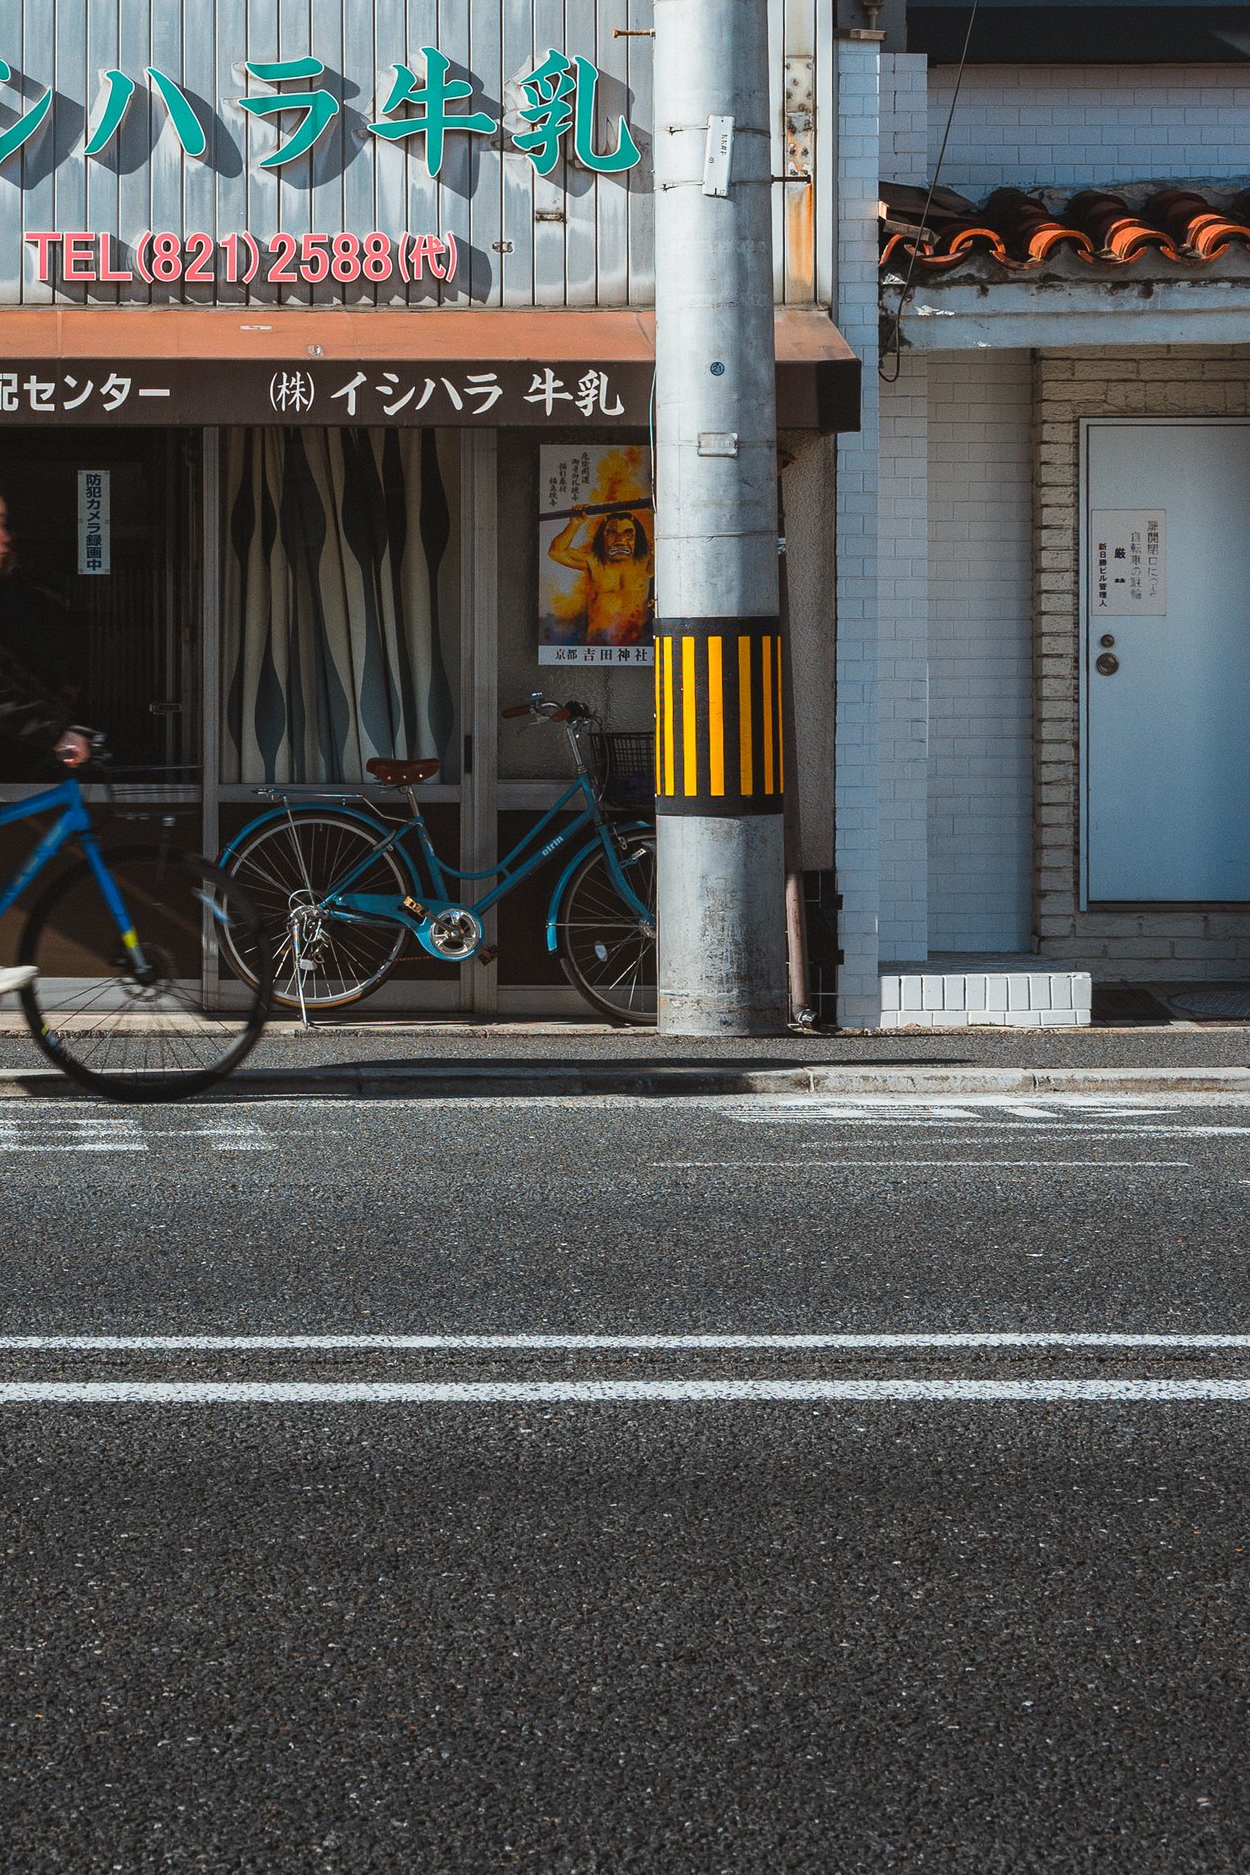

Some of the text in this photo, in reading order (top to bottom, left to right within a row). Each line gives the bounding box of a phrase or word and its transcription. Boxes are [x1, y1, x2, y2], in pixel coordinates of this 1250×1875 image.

[330, 370, 503, 416] イシハラ
[523, 368, 625, 417] 牛乳
[86, 474, 102, 571] 防犯カメラ録画中
